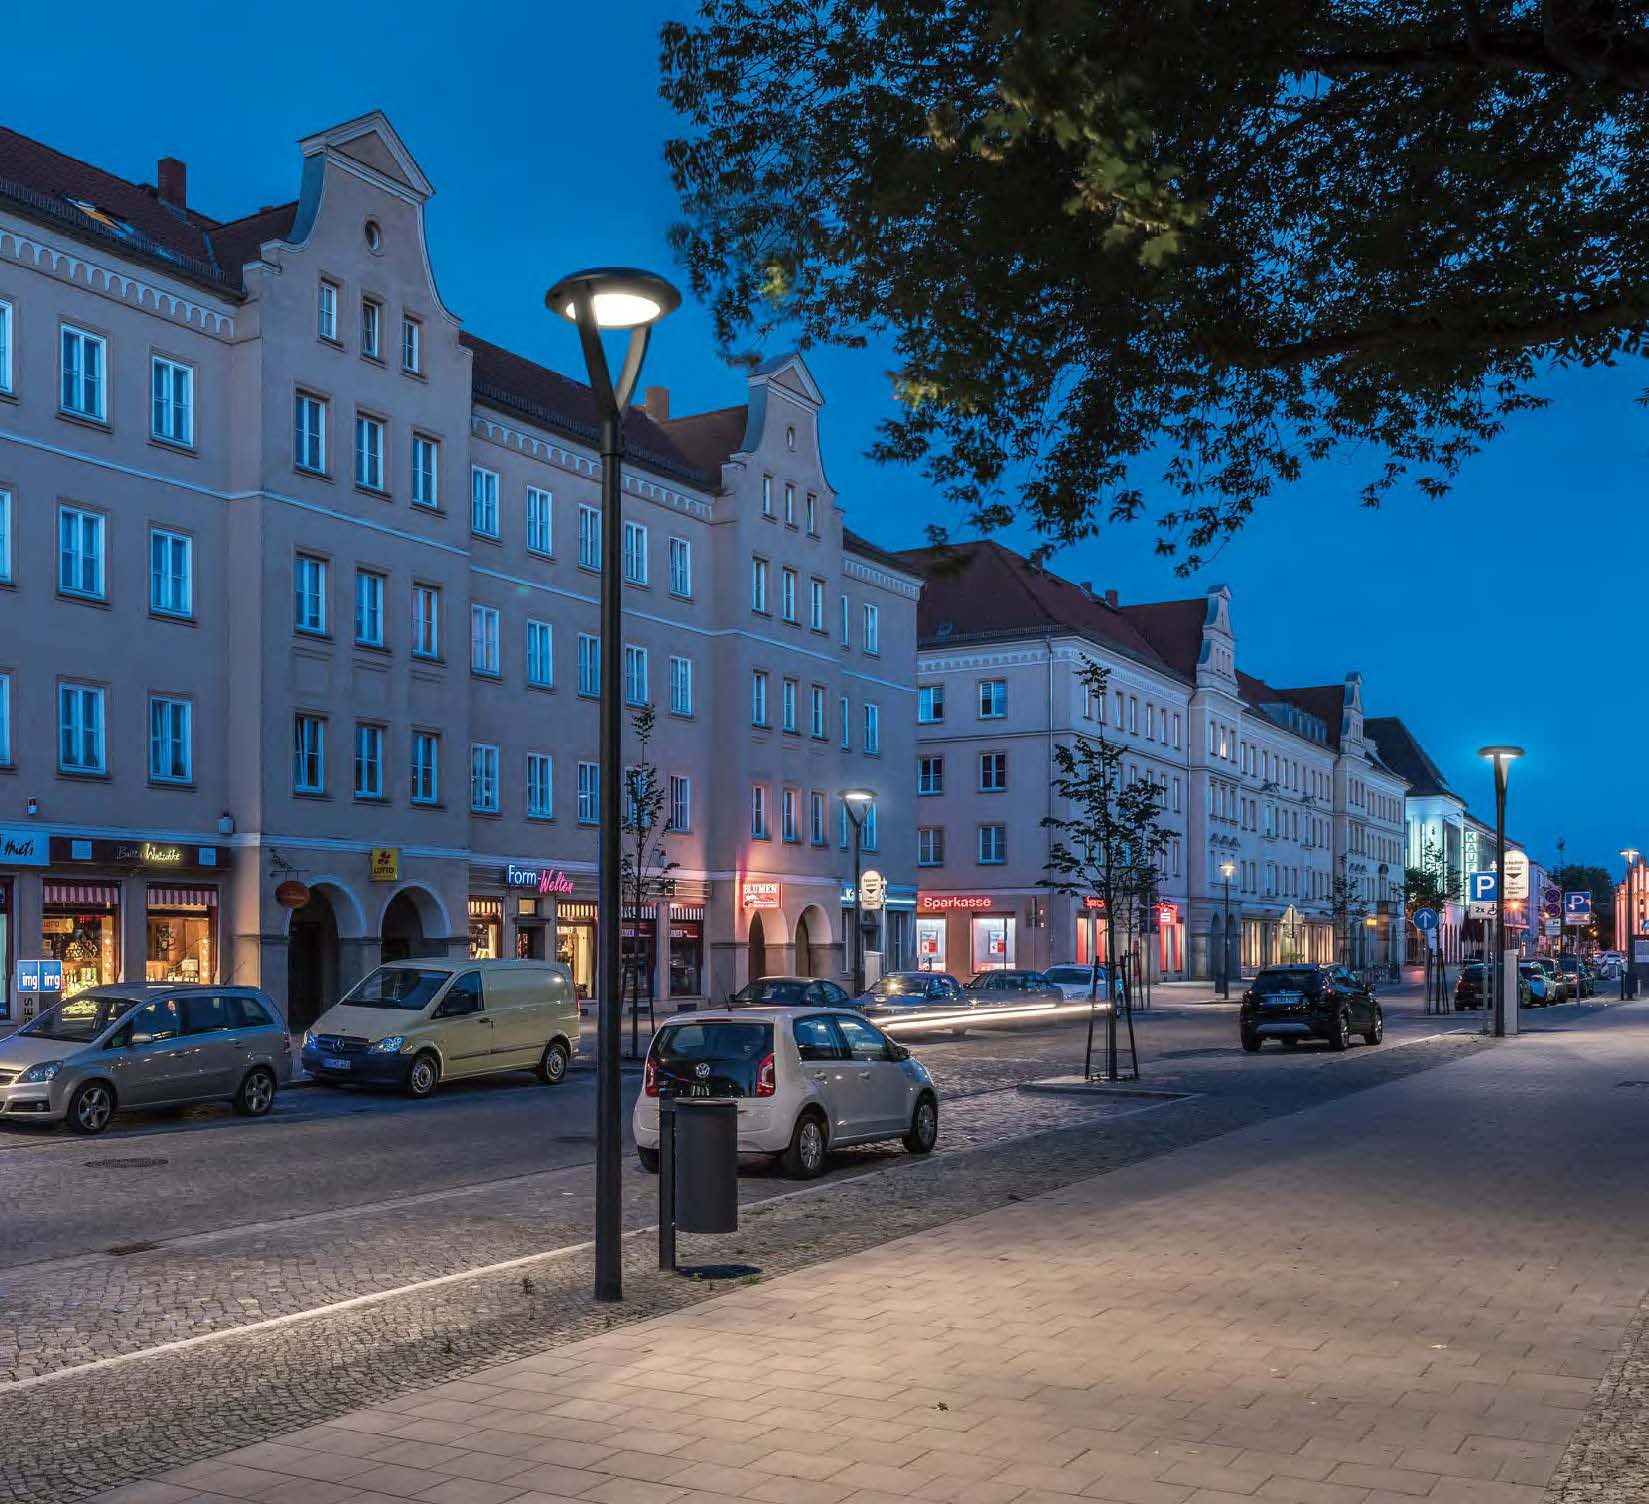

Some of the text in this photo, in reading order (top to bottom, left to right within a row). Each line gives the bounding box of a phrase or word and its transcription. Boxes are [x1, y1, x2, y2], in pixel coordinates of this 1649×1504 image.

[1476, 876, 1495, 899] P
[923, 897, 992, 910] Sparkasse
[1571, 895, 1585, 910] P
[22, 972, 38, 990] img
